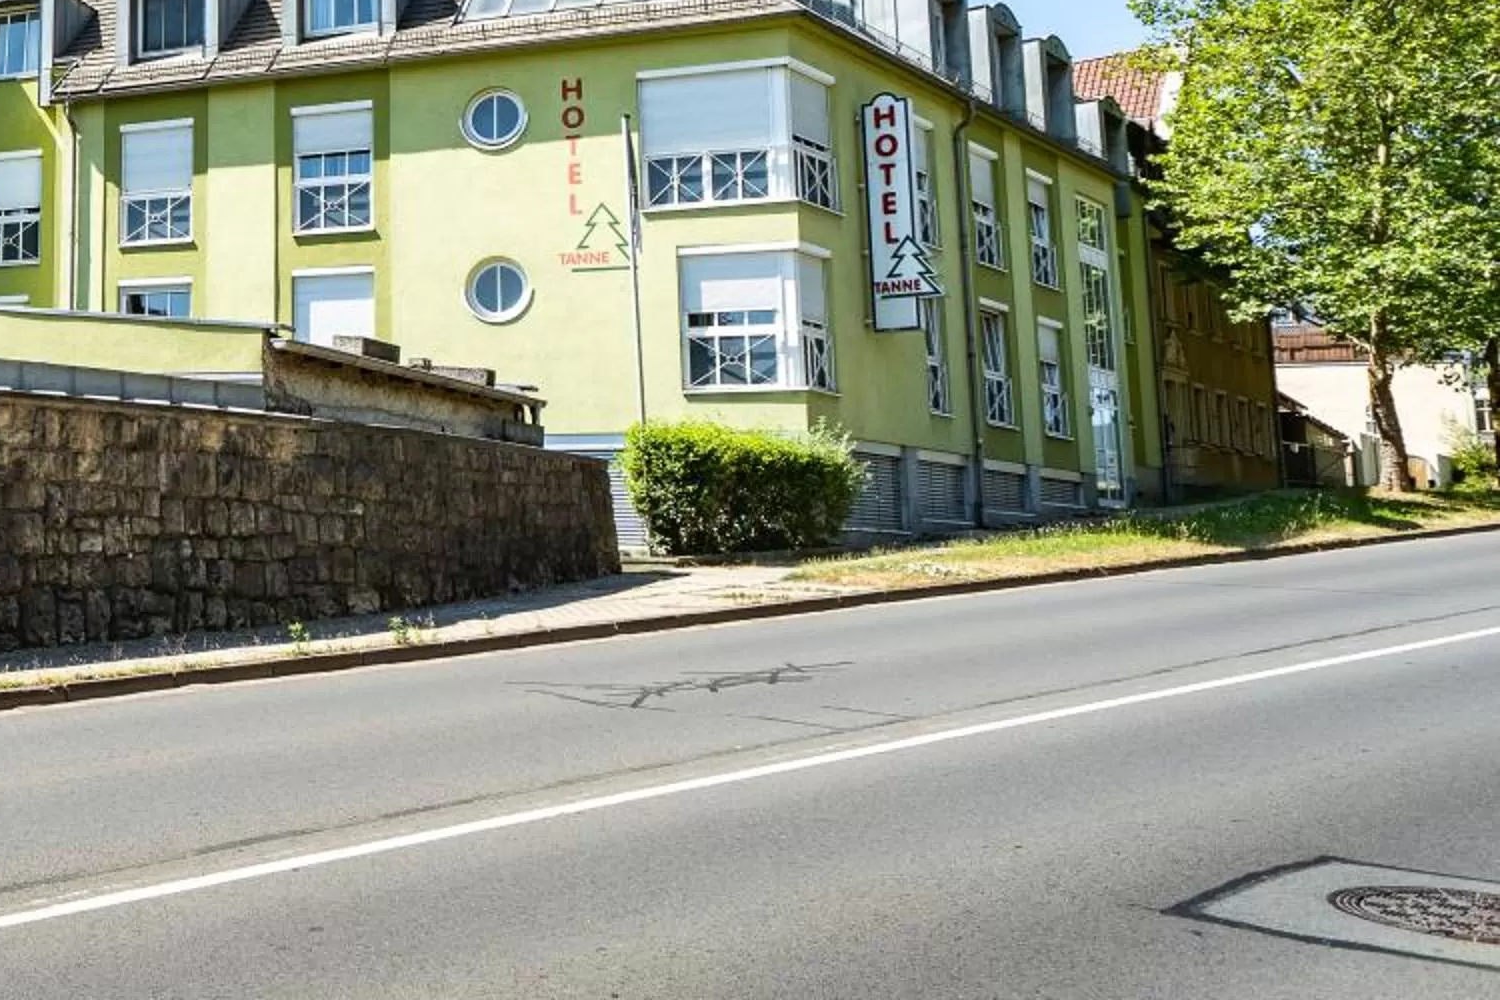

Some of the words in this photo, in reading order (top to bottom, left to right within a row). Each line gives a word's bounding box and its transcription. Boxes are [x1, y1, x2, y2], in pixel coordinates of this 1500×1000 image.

[561, 77, 584, 216] HOTEL
[872, 104, 899, 245] HOTEL
[558, 252, 610, 265] TANNE
[874, 278, 922, 294] TANNE
